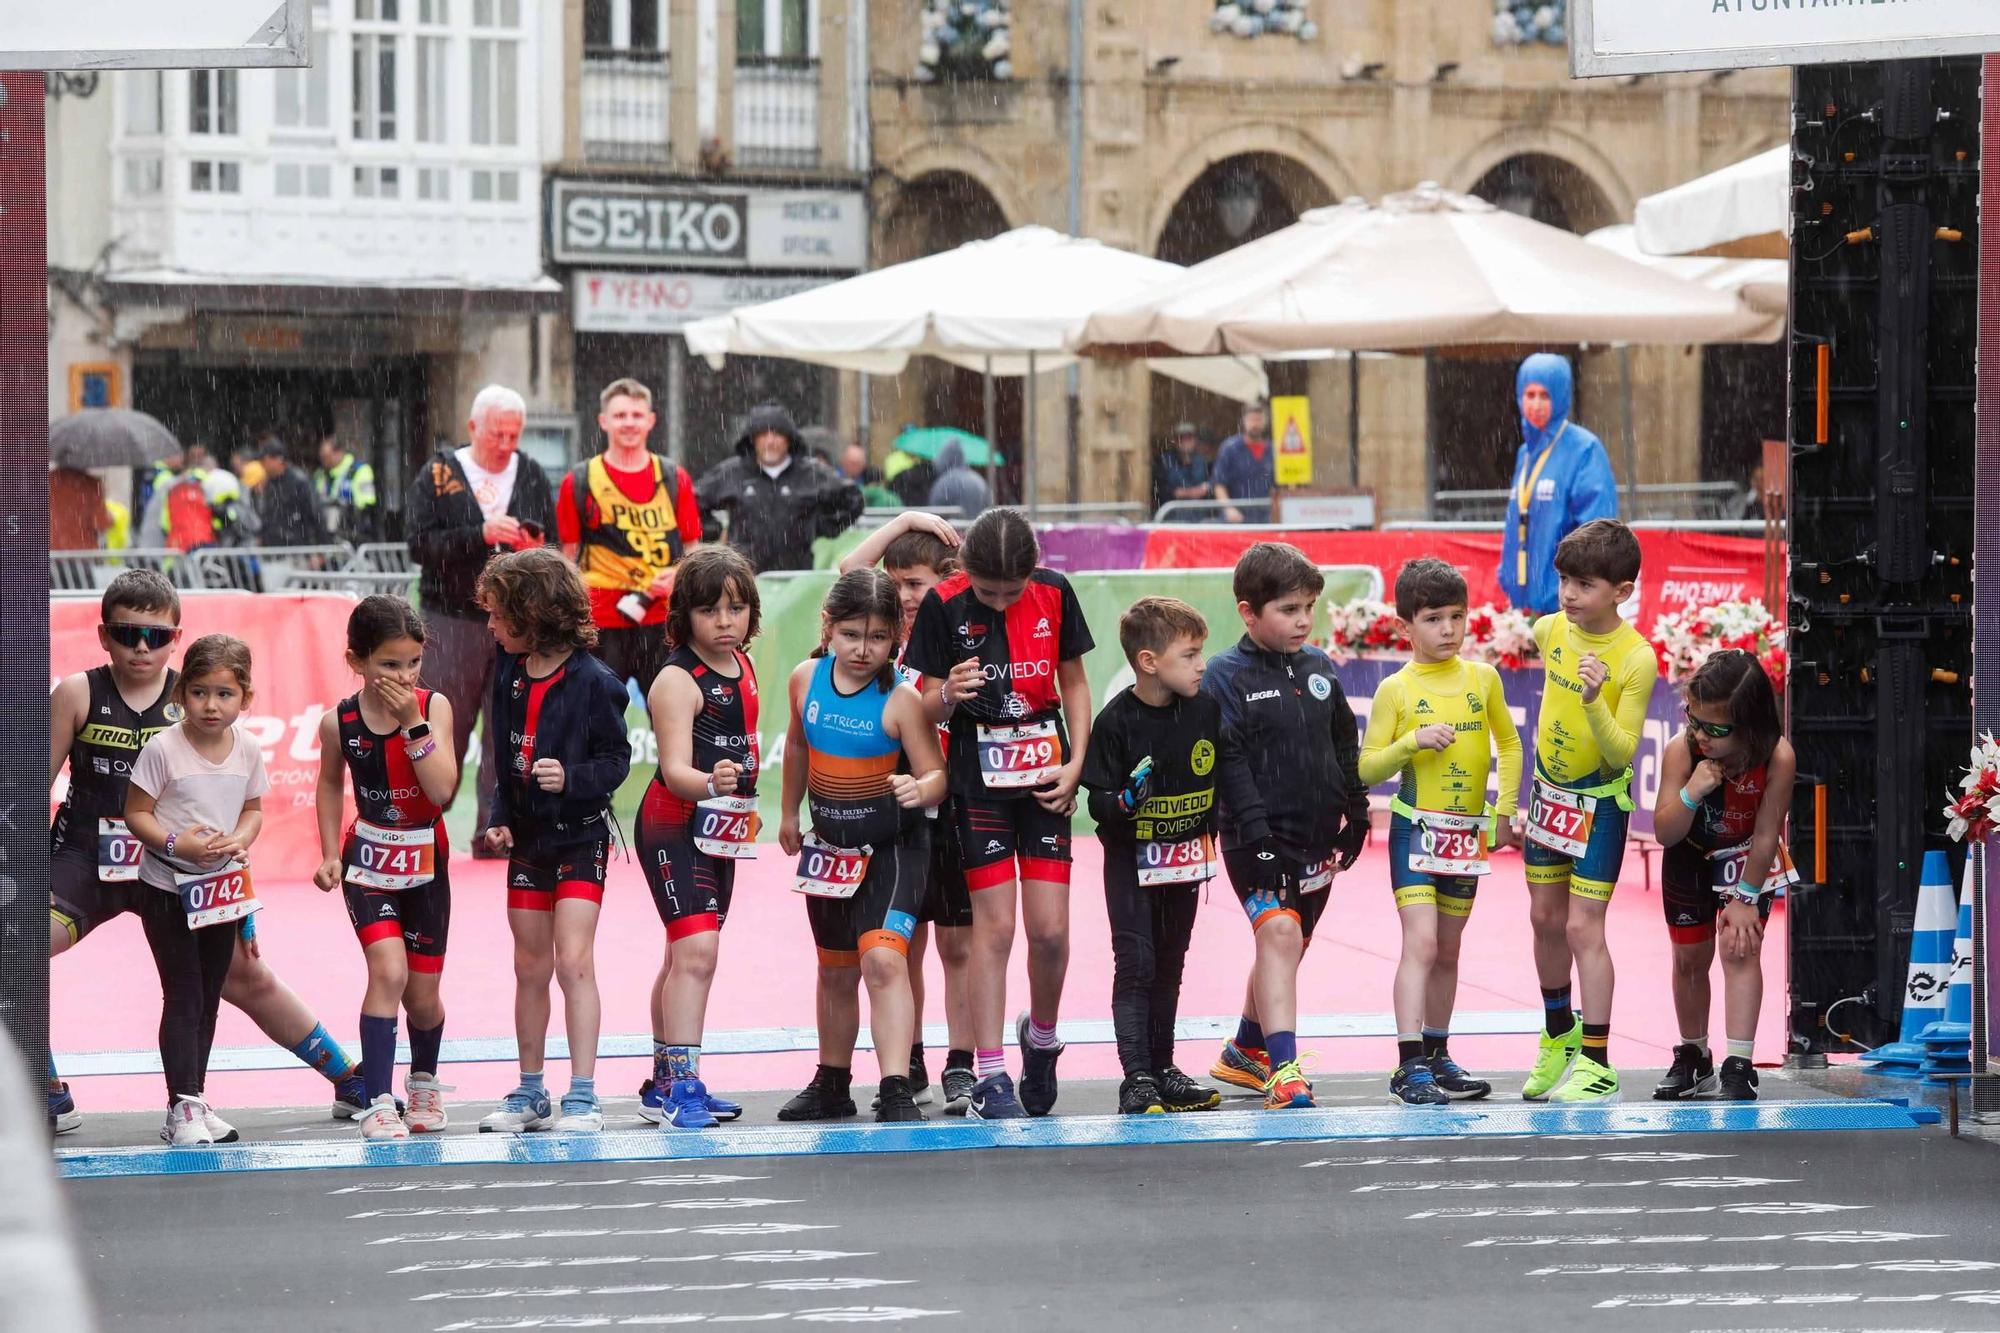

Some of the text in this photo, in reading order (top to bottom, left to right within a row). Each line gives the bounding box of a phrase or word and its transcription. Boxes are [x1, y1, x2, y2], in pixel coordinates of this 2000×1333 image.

[566, 201, 741, 252] SEIKO
[627, 531, 670, 567] 95
[983, 659, 1051, 681] OVIEDO
[1246, 689, 1281, 702] LEGEA
[1454, 721, 1483, 732] ALBACETE
[988, 741, 1053, 770] 0749
[369, 785, 420, 801] OVIEDO
[842, 807, 876, 816] RURAL
[1157, 815, 1202, 836] OVIEDO
[1533, 799, 1585, 836] 0747
[702, 813, 750, 840] 0745
[1145, 837, 1205, 867] 0738
[1420, 830, 1480, 857] 0739
[360, 843, 422, 873] 0741
[807, 852, 864, 882] 0744
[189, 875, 246, 909] 0742
